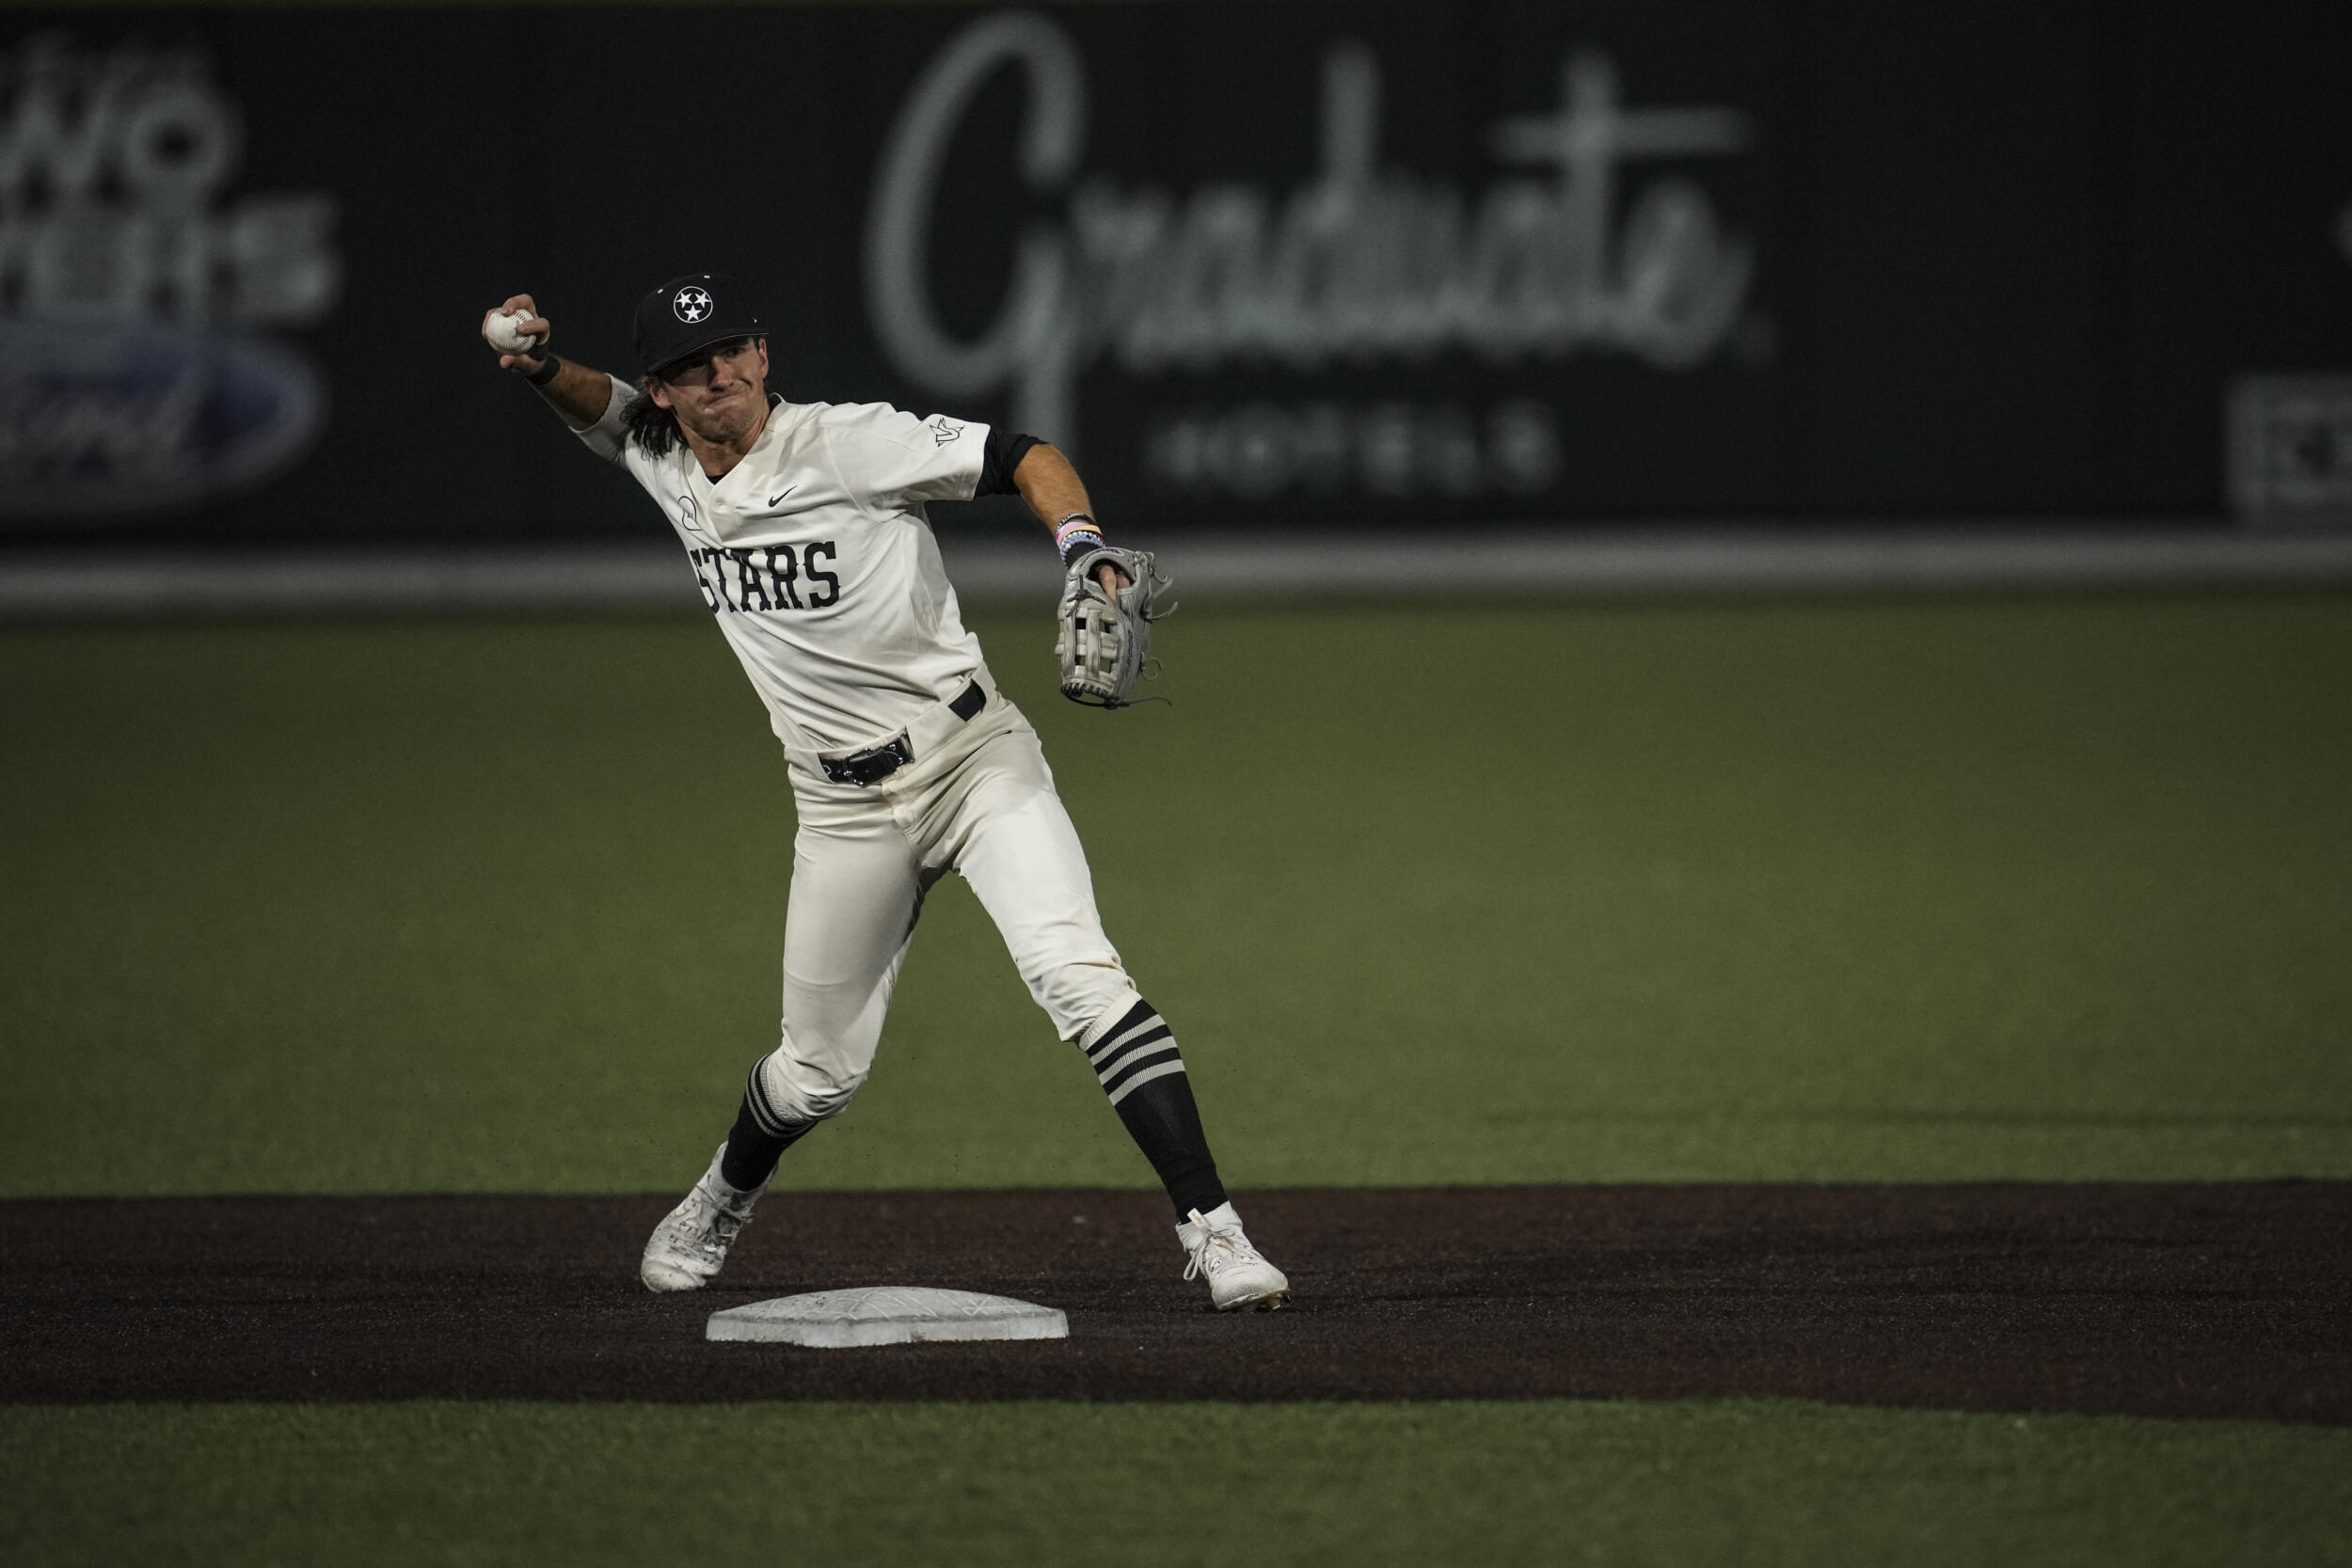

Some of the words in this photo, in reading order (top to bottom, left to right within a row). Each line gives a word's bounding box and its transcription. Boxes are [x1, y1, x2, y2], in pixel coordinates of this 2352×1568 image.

[864, 11, 1752, 466] Graduate
[1145, 407, 1557, 491] HOTELS
[690, 540, 840, 614] STARS
